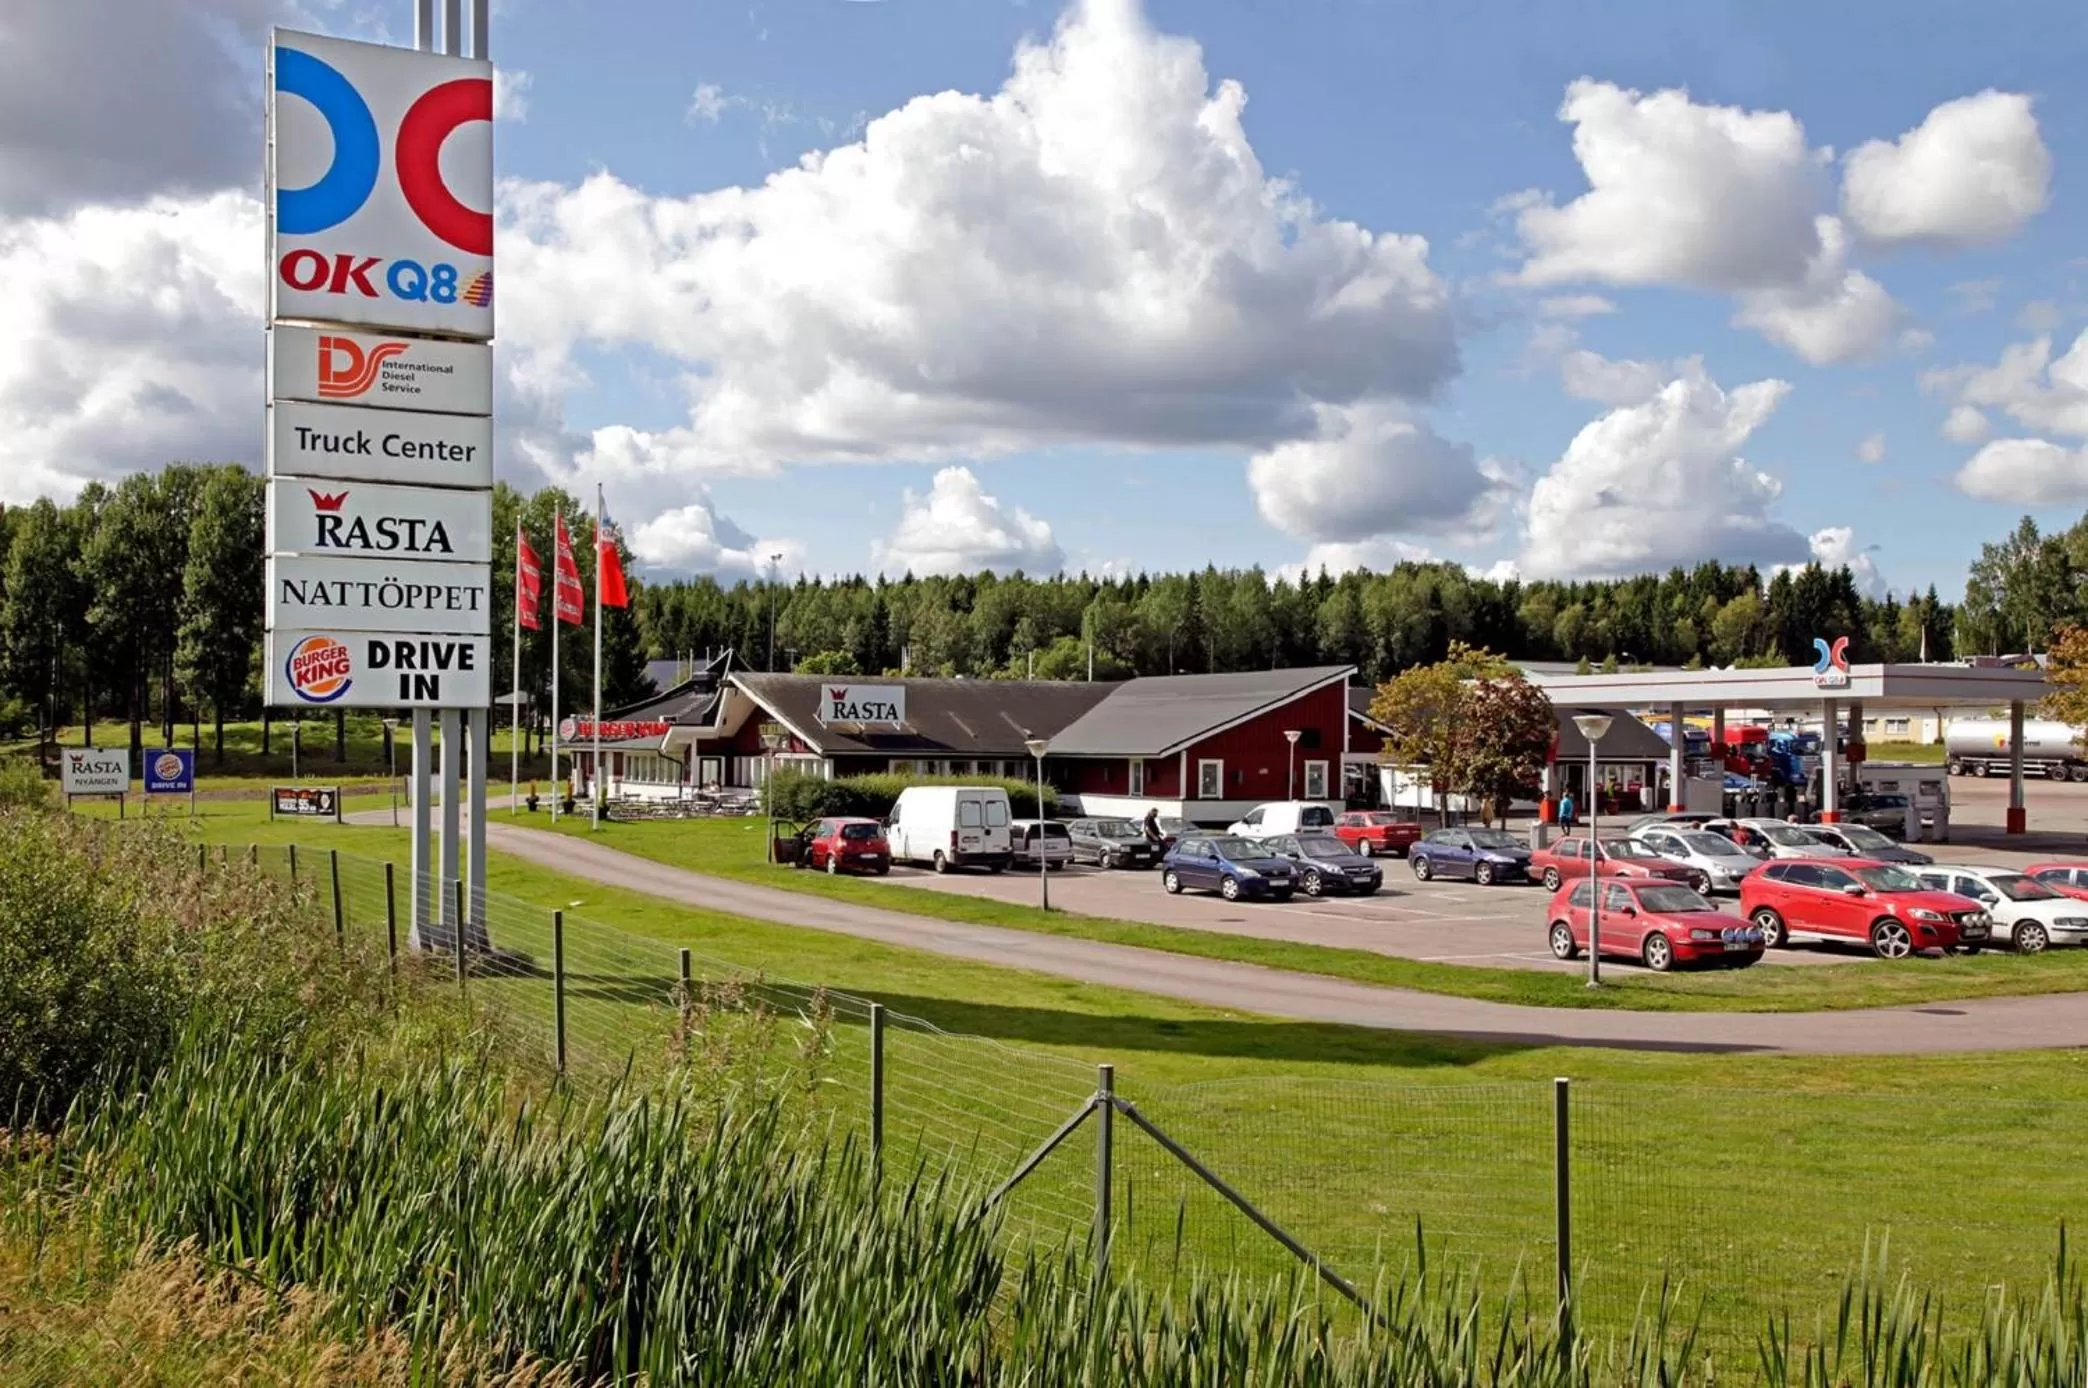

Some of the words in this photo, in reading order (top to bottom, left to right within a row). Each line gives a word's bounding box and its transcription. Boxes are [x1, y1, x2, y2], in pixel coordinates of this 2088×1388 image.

[382, 360, 454, 375] International
[382, 371, 415, 382] Diesel
[382, 382, 422, 394] Service
[294, 426, 372, 456] Truck
[382, 434, 476, 462] Center
[315, 514, 454, 554] RASTA
[280, 575, 484, 611] NATTÖPPET
[294, 646, 347, 671] BURGER
[367, 640, 475, 671] DRIVE
[297, 658, 350, 688] KING
[399, 674, 439, 701] IN
[833, 701, 899, 720] RASTA
[71, 761, 122, 774] RASTA
[151, 781, 176, 789] DRIVE
